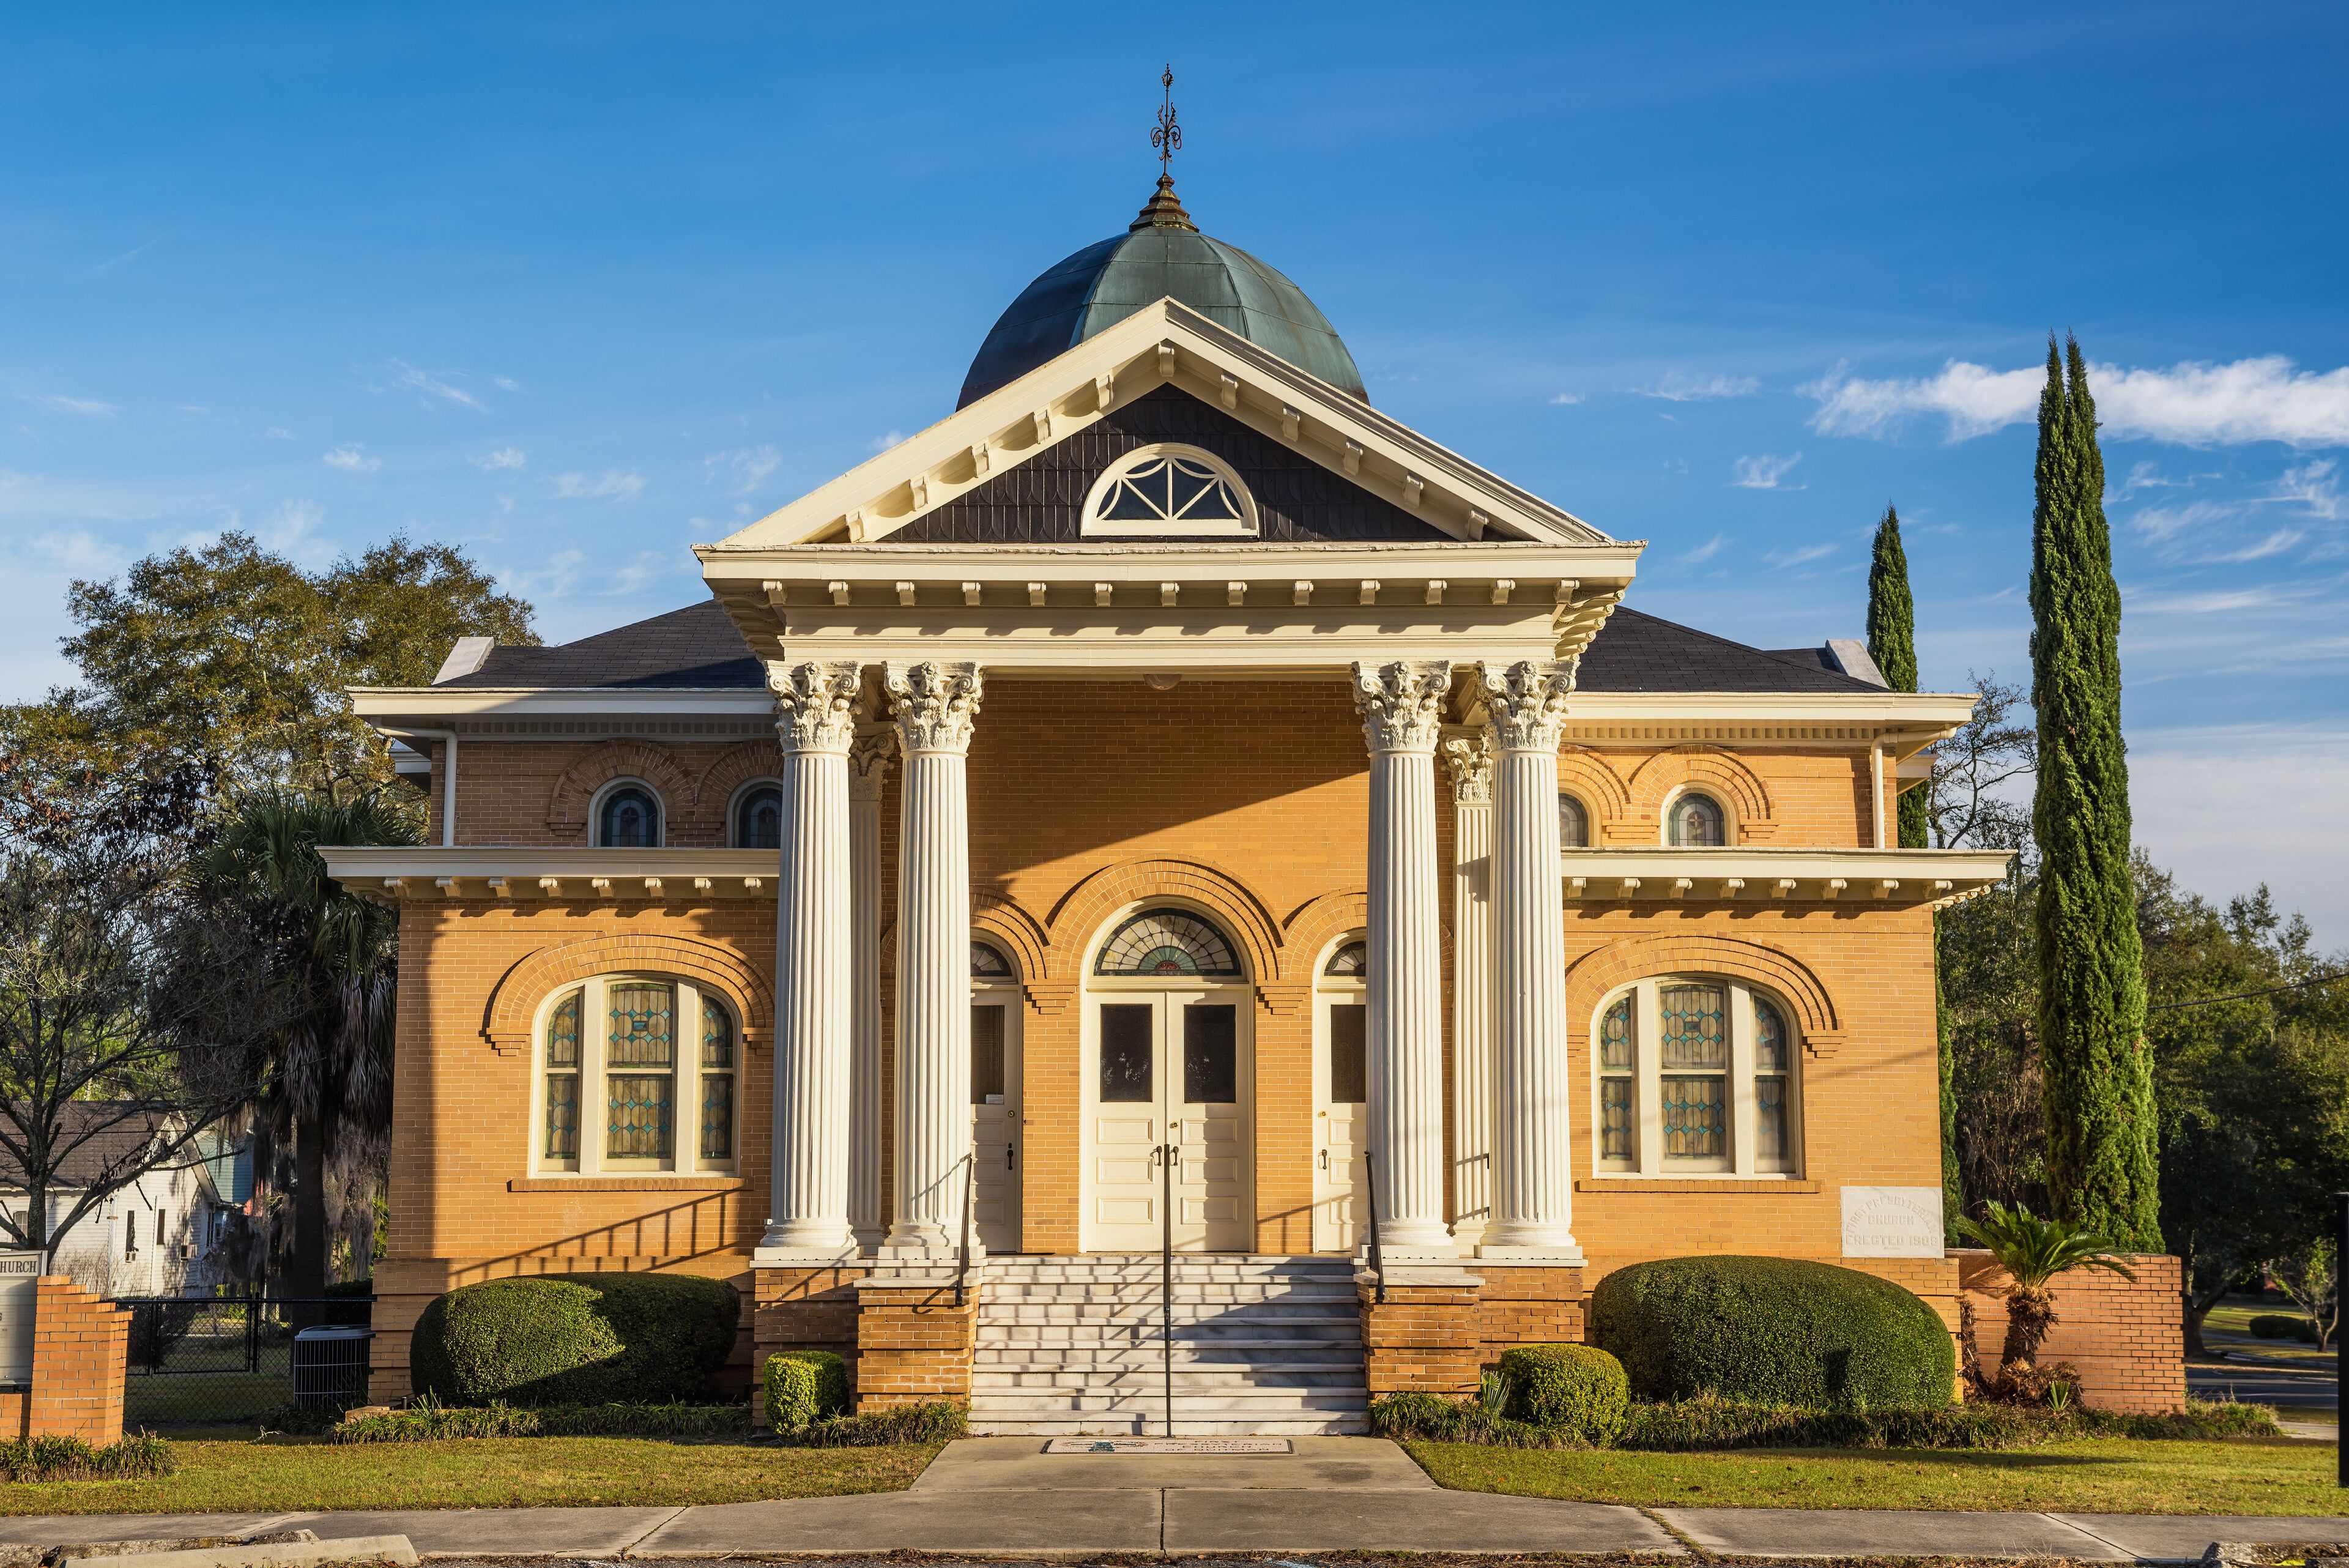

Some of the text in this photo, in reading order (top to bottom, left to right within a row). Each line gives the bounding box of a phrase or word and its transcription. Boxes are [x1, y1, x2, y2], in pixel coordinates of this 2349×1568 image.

[1846, 1195, 1939, 1234] FIRST PRESBYTERIAN
[1868, 1214, 1915, 1225] CHURCH
[1846, 1234, 1906, 1246] ERECTED
